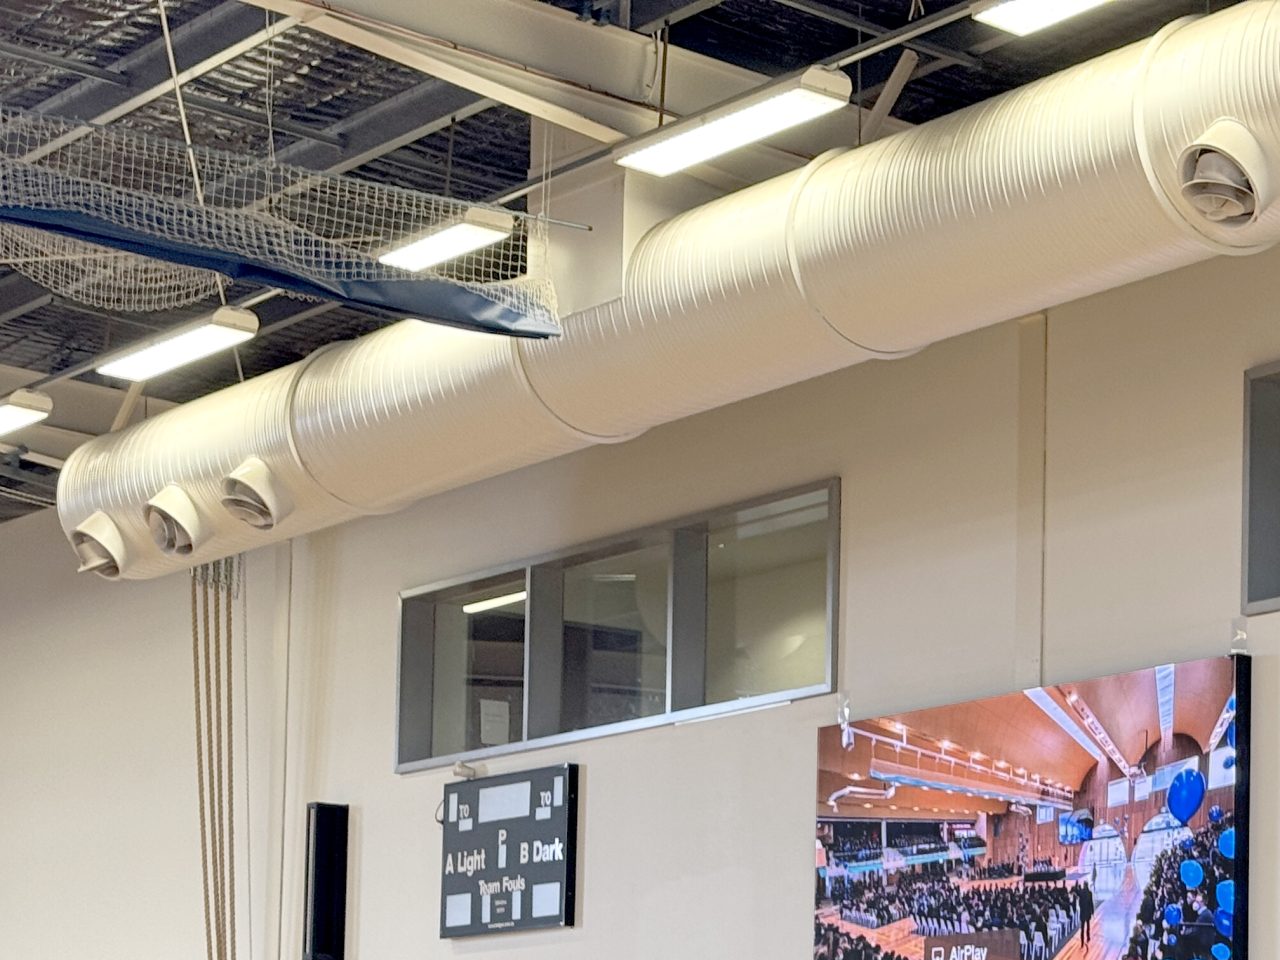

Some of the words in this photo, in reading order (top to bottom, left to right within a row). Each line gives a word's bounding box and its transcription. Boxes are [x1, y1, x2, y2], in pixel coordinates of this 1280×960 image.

[445, 854, 454, 875] A
[457, 849, 486, 876] Light
[520, 842, 529, 864] B
[533, 837, 564, 863] Dark
[478, 880, 500, 896] Team
[503, 874, 526, 893] Fouls
